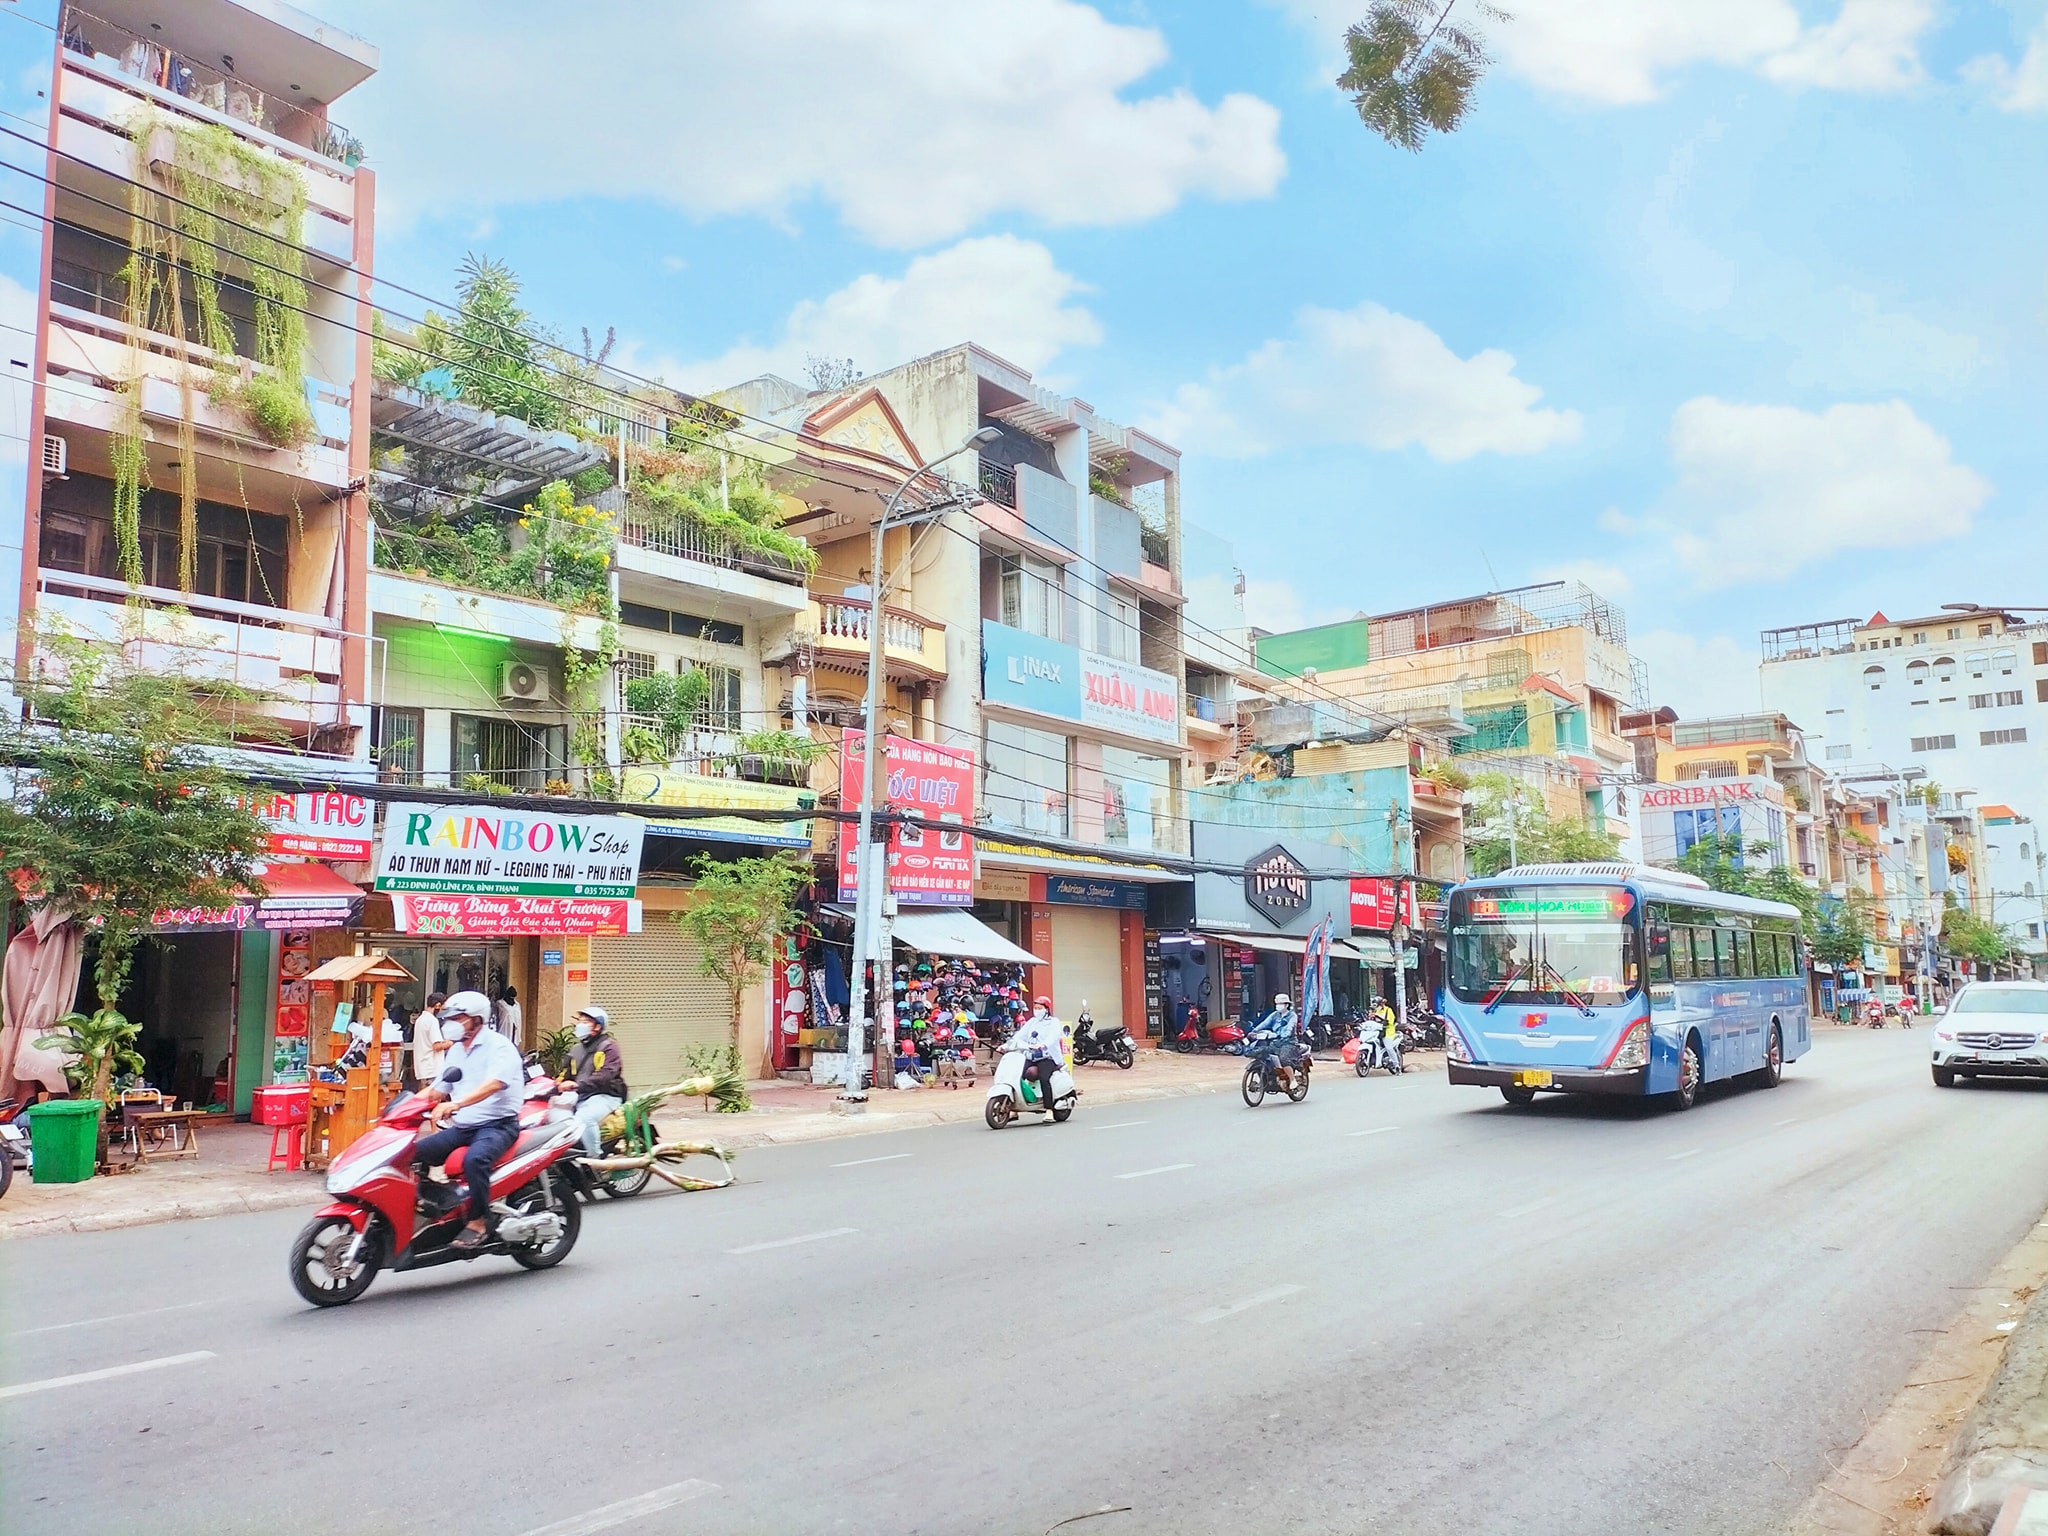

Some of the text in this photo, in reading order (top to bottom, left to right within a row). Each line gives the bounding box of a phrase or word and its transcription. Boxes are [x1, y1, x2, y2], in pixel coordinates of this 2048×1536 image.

[1084, 671, 1176, 723] XUÂN ANH
[902, 745, 921, 763] HÀNG
[923, 748, 937, 765] NÓN
[920, 776, 959, 809] VIỆT
[1641, 782, 1754, 807] AGRIBANK
[405, 813, 630, 859] RAINBOW Shop
[388, 851, 405, 872] ÁO
[410, 856, 440, 874] THUN
[444, 858, 472, 875] NAM
[474, 856, 492, 876] NỮ
[503, 861, 549, 878] LEGGING
[552, 861, 575, 880] THÁI
[586, 865, 607, 884] PHỤ
[609, 863, 632, 885] KIỆN
[1256, 854, 1307, 900] MOTOR
[430, 881, 441, 890] BỘ
[476, 883, 494, 892] BÌNH
[495, 885, 519, 894] THẠNH
[584, 887, 629, 896] 035 7575 267
[1057, 880, 1086, 895] American
[1086, 884, 1116, 897] Standard
[414, 896, 460, 916] Tưng
[464, 896, 510, 916] Bừng
[512, 898, 555, 915] Khai
[1265, 895, 1299, 908] ZONE
[1350, 892, 1377, 907] MOTUL
[152, 904, 254, 928] Beauty
[417, 915, 464, 934] 20%
[467, 916, 498, 928] Giảm
[499, 916, 519, 928] Giá
[522, 917, 540, 926] Các
[541, 917, 561, 926] Sản
[563, 916, 594, 928] Phẩm
[1592, 977, 1609, 993] 8
